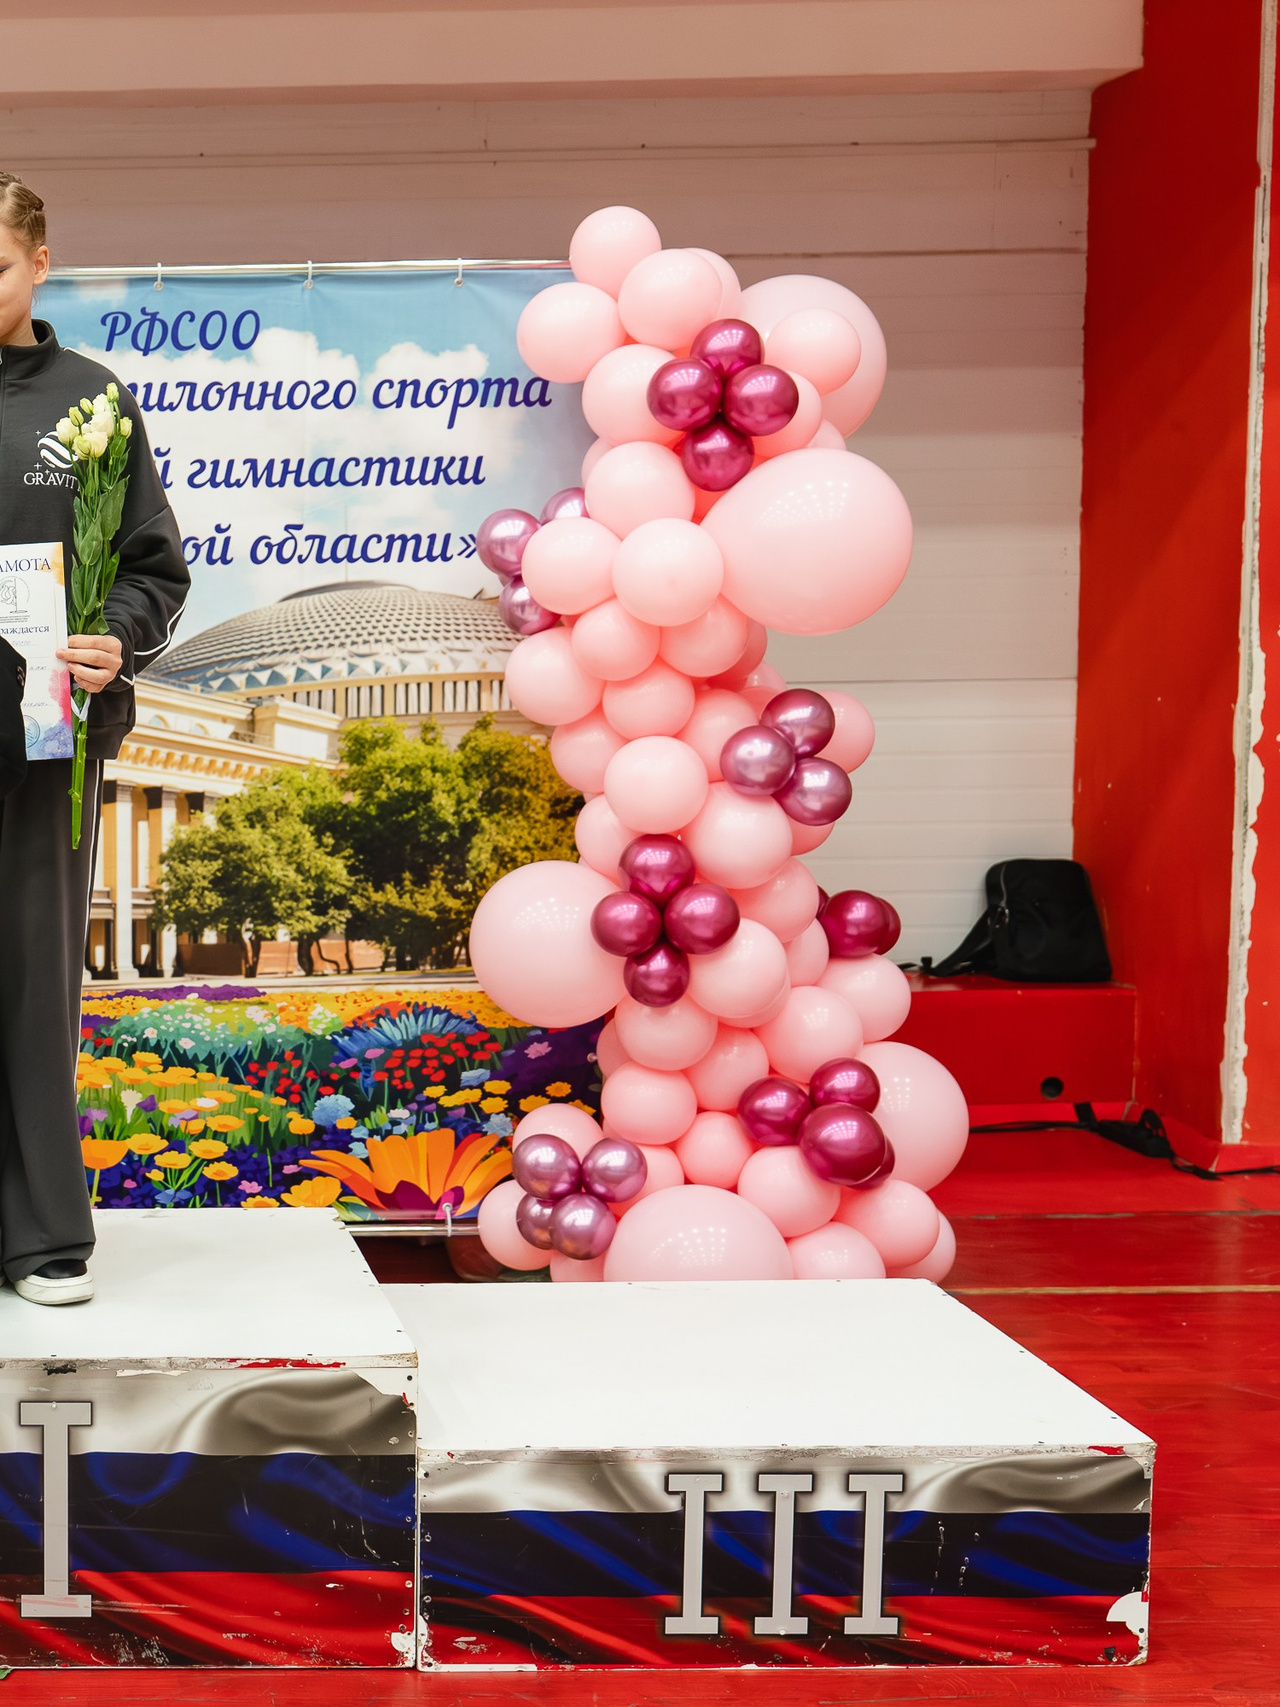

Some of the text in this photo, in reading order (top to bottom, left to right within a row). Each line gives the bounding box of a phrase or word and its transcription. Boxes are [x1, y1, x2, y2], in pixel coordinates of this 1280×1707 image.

[100, 306, 261, 357] РФСОО
[372, 376, 553, 430] спорта
[23, 472, 81, 492] GRAVIT
[187, 456, 487, 489] гимнастики
[249, 524, 477, 566] области»
[19, 1401, 93, 1619] I
[664, 1472, 901, 1636] III
